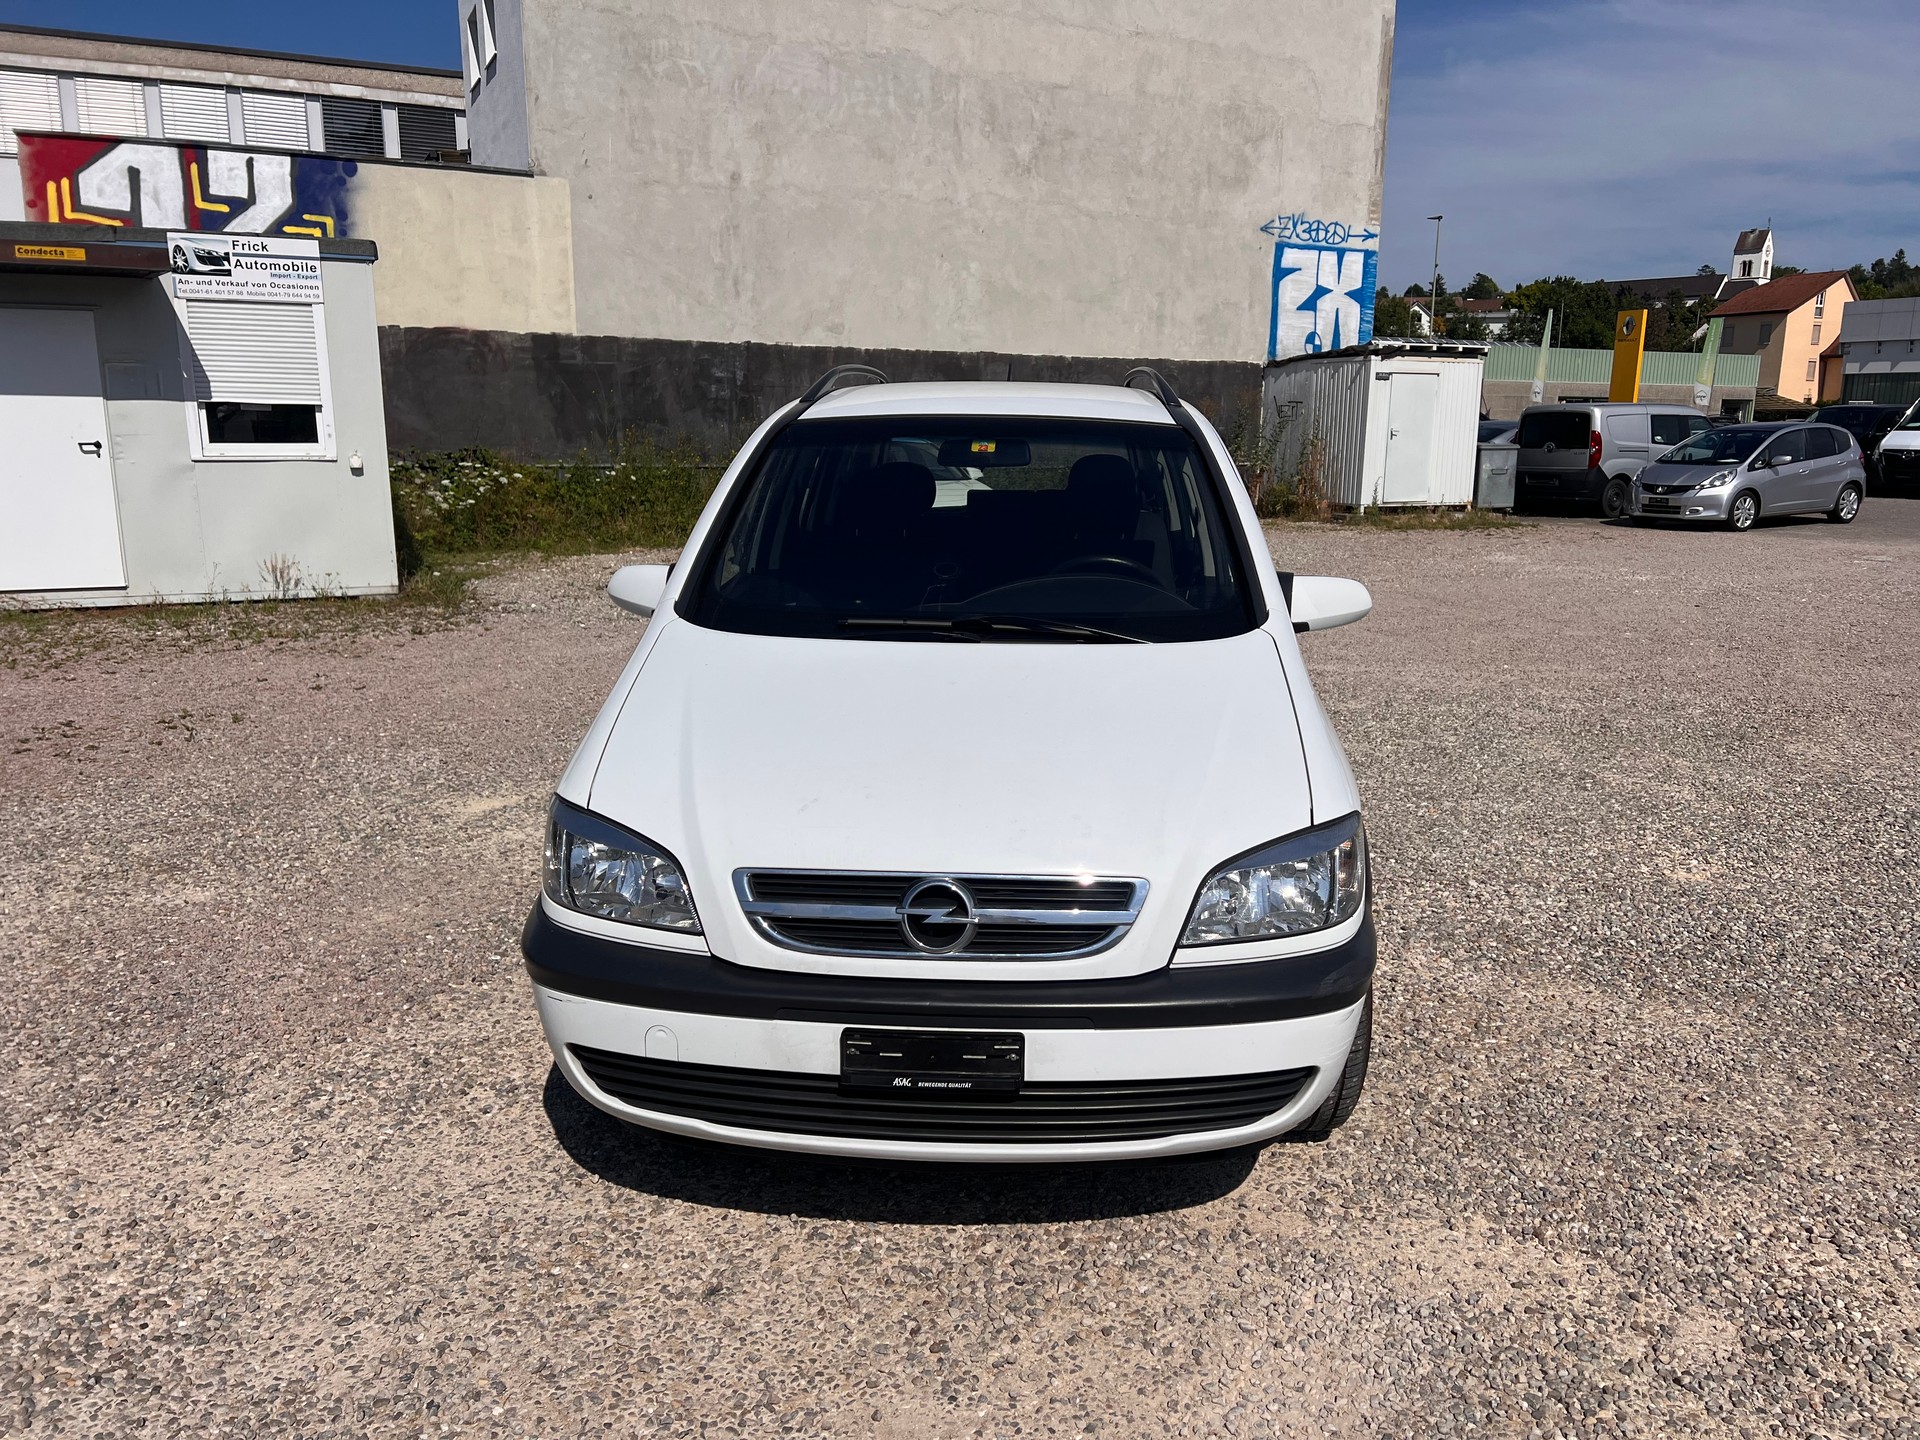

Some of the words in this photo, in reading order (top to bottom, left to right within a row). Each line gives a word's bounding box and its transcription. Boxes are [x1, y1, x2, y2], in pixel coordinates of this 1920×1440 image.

[17, 246, 65, 257] Condecta
[232, 240, 269, 252] Frick
[233, 258, 317, 273] Automobile
[270, 272, 292, 280] Import
[297, 273, 319, 281] Export
[177, 277, 194, 286] An-
[195, 279, 213, 287] und
[214, 279, 249, 288] Verkauf
[250, 281, 267, 289] von
[269, 281, 320, 291] Occasionen
[892, 1077, 912, 1087] ASAG
